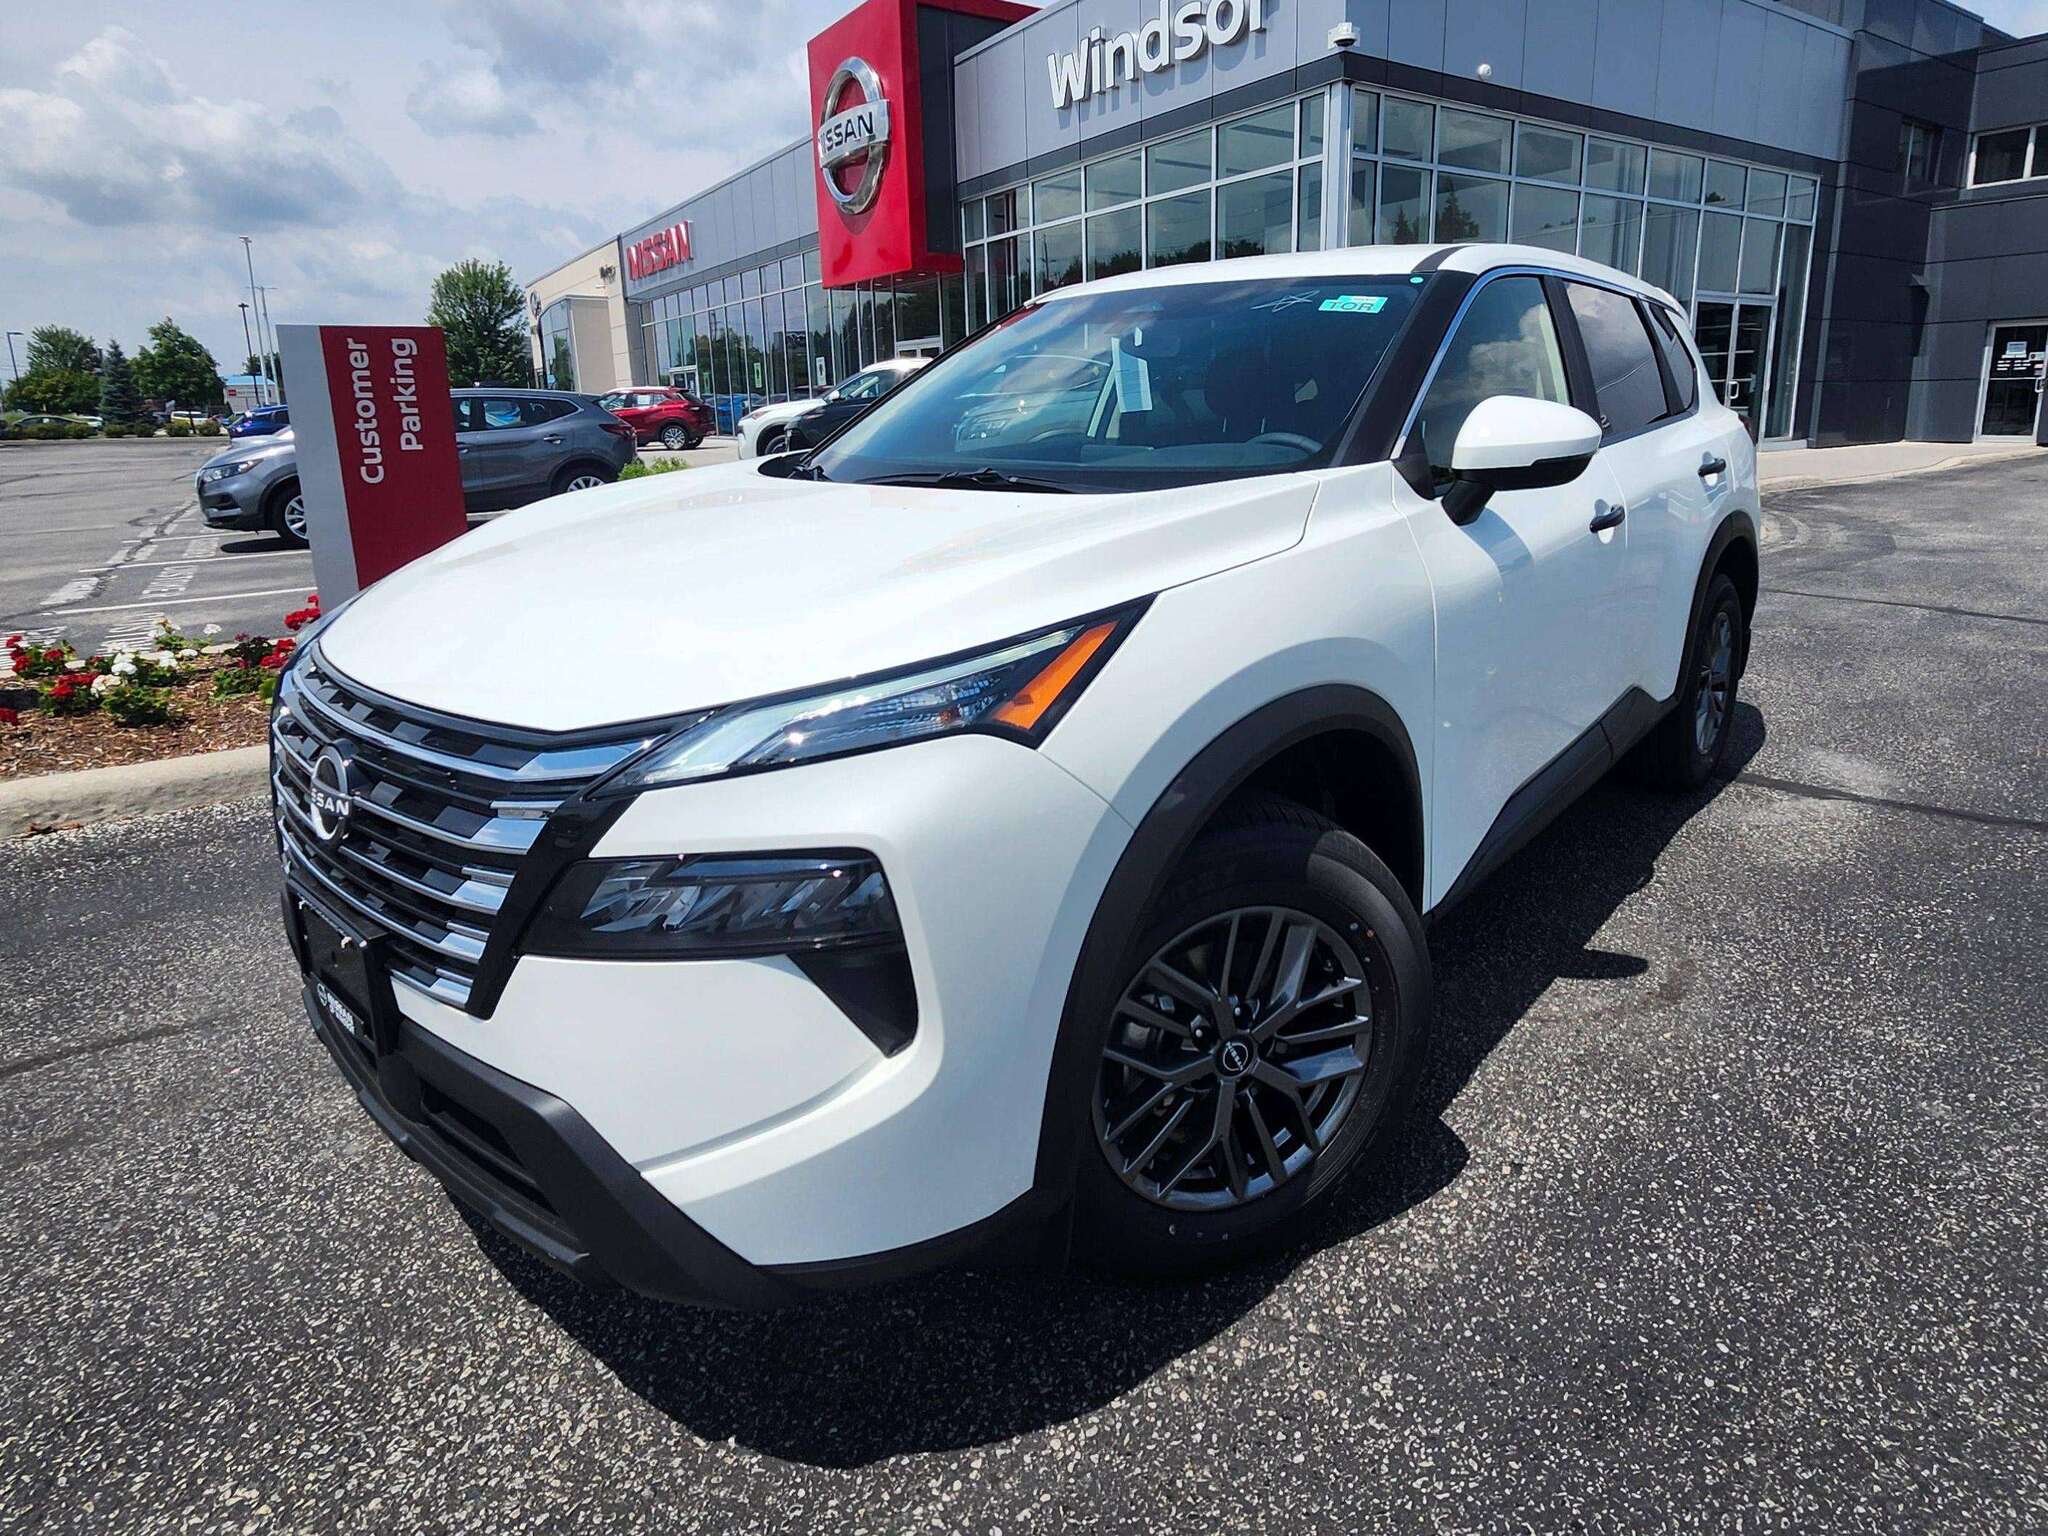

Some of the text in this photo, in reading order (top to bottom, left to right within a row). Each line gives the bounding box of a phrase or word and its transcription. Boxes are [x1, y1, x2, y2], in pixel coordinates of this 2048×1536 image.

[627, 221, 690, 281] NISSAN
[347, 337, 385, 484] Customer
[390, 338, 424, 451] Parking
